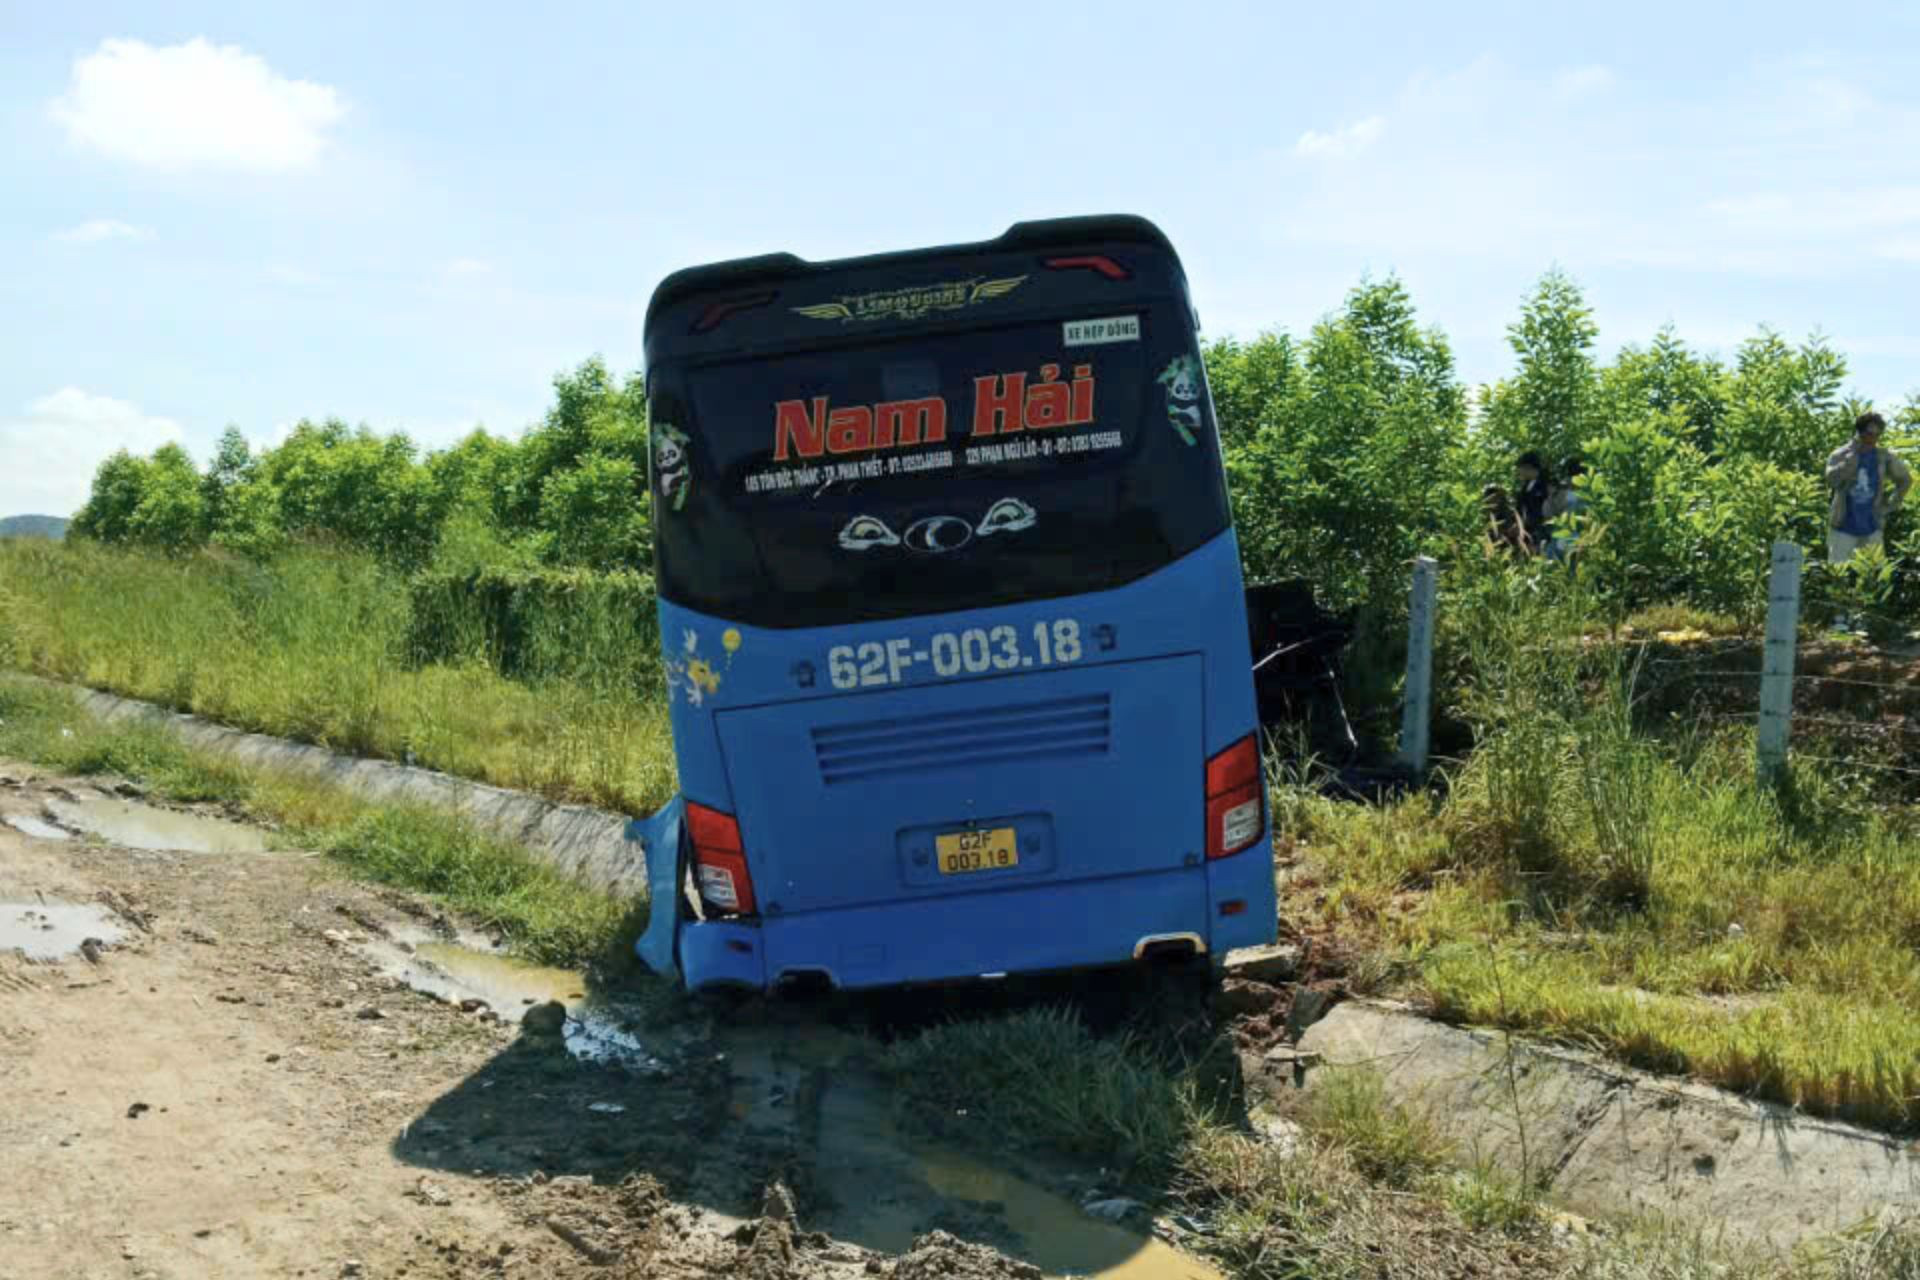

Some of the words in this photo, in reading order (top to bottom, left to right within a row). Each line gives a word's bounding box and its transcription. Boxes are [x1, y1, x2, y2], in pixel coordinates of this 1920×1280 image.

[1067, 326, 1081, 340] XE
[773, 396, 946, 461] Nam
[970, 363, 1095, 436] Hải
[828, 618, 1082, 690] 62F-003.18
[947, 848, 1009, 871] 003.18
